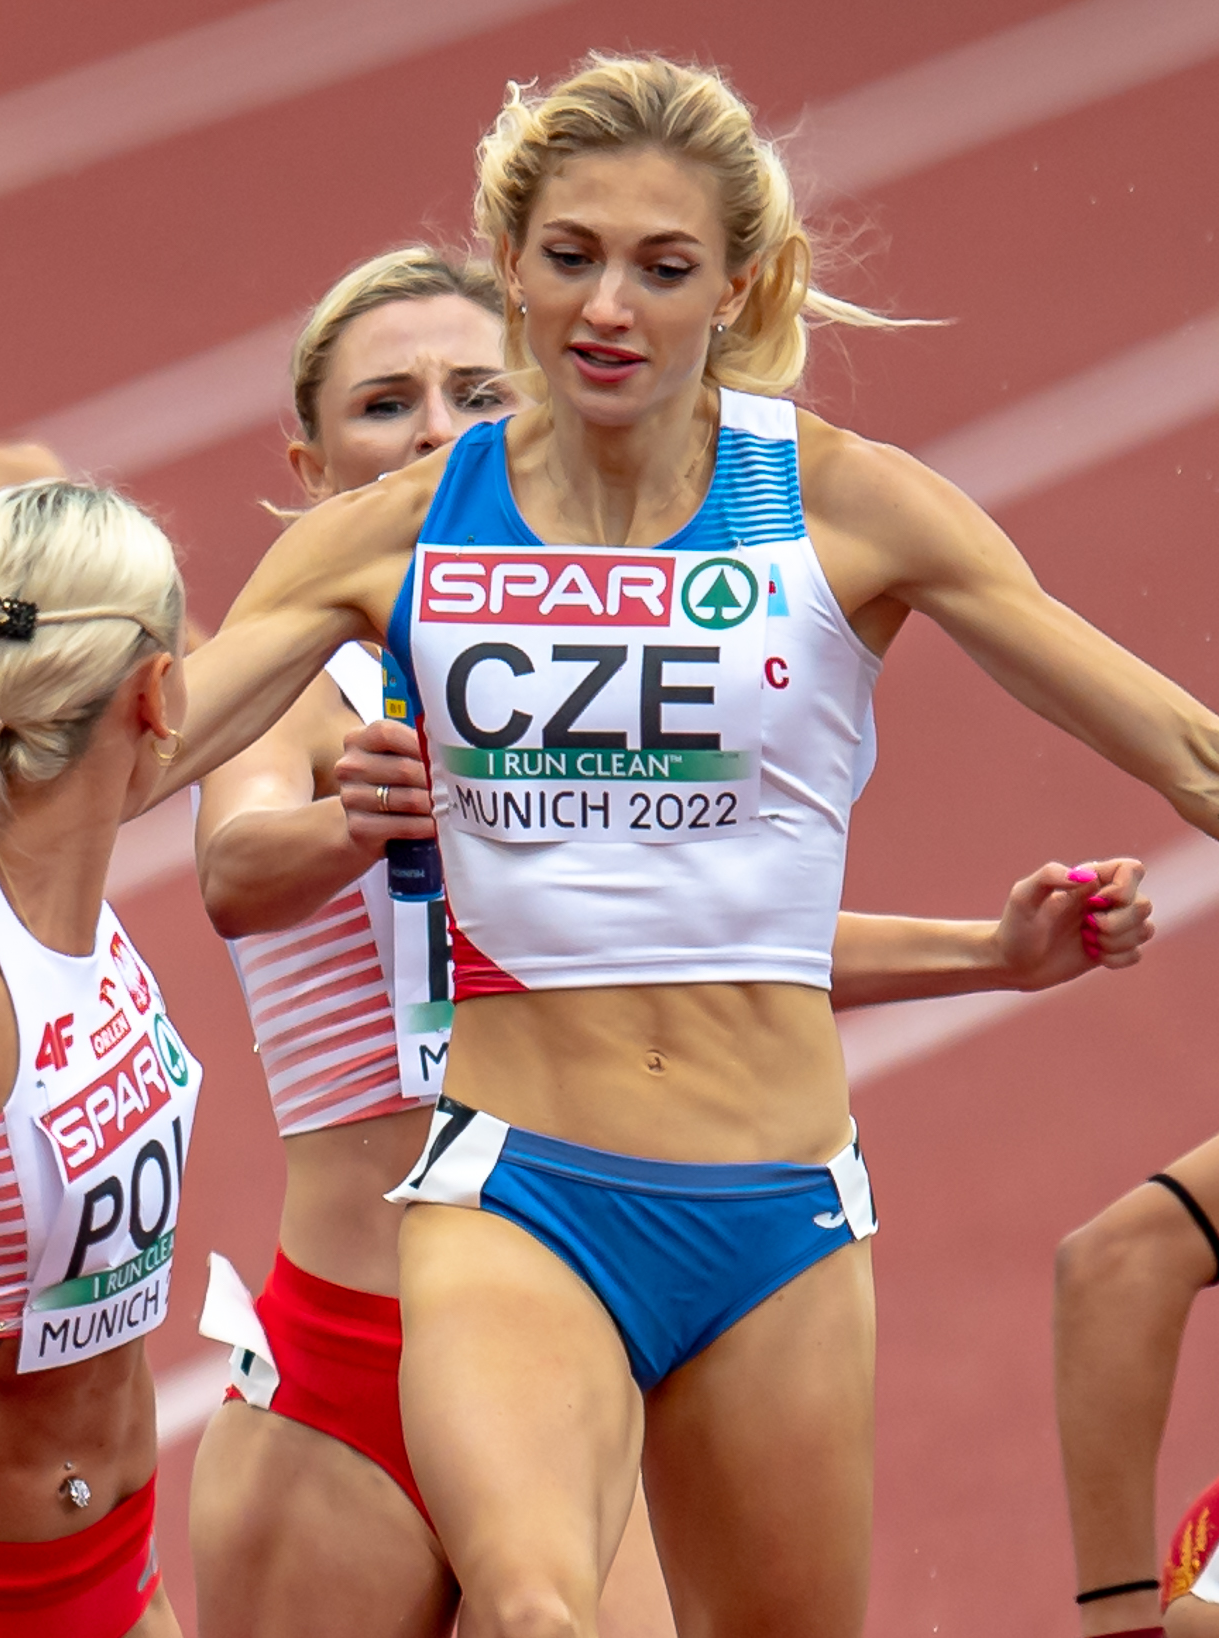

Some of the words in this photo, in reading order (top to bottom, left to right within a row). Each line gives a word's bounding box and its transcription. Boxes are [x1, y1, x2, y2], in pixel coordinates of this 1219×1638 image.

[428, 562, 667, 617] SPAR
[446, 642, 721, 750] CZE
[760, 656, 790, 690] C
[488, 753, 494, 775] I
[505, 753, 566, 776] RUN
[456, 785, 610, 829] MUNICH
[630, 792, 737, 829] 2022
[35, 1012, 74, 1071] 4F
[93, 1014, 130, 1054] ORLEN
[51, 1045, 166, 1169] SPAR
[93, 1277, 100, 1299] I
[106, 1258, 143, 1295] RUN
[38, 1280, 160, 1358] MUNICH
